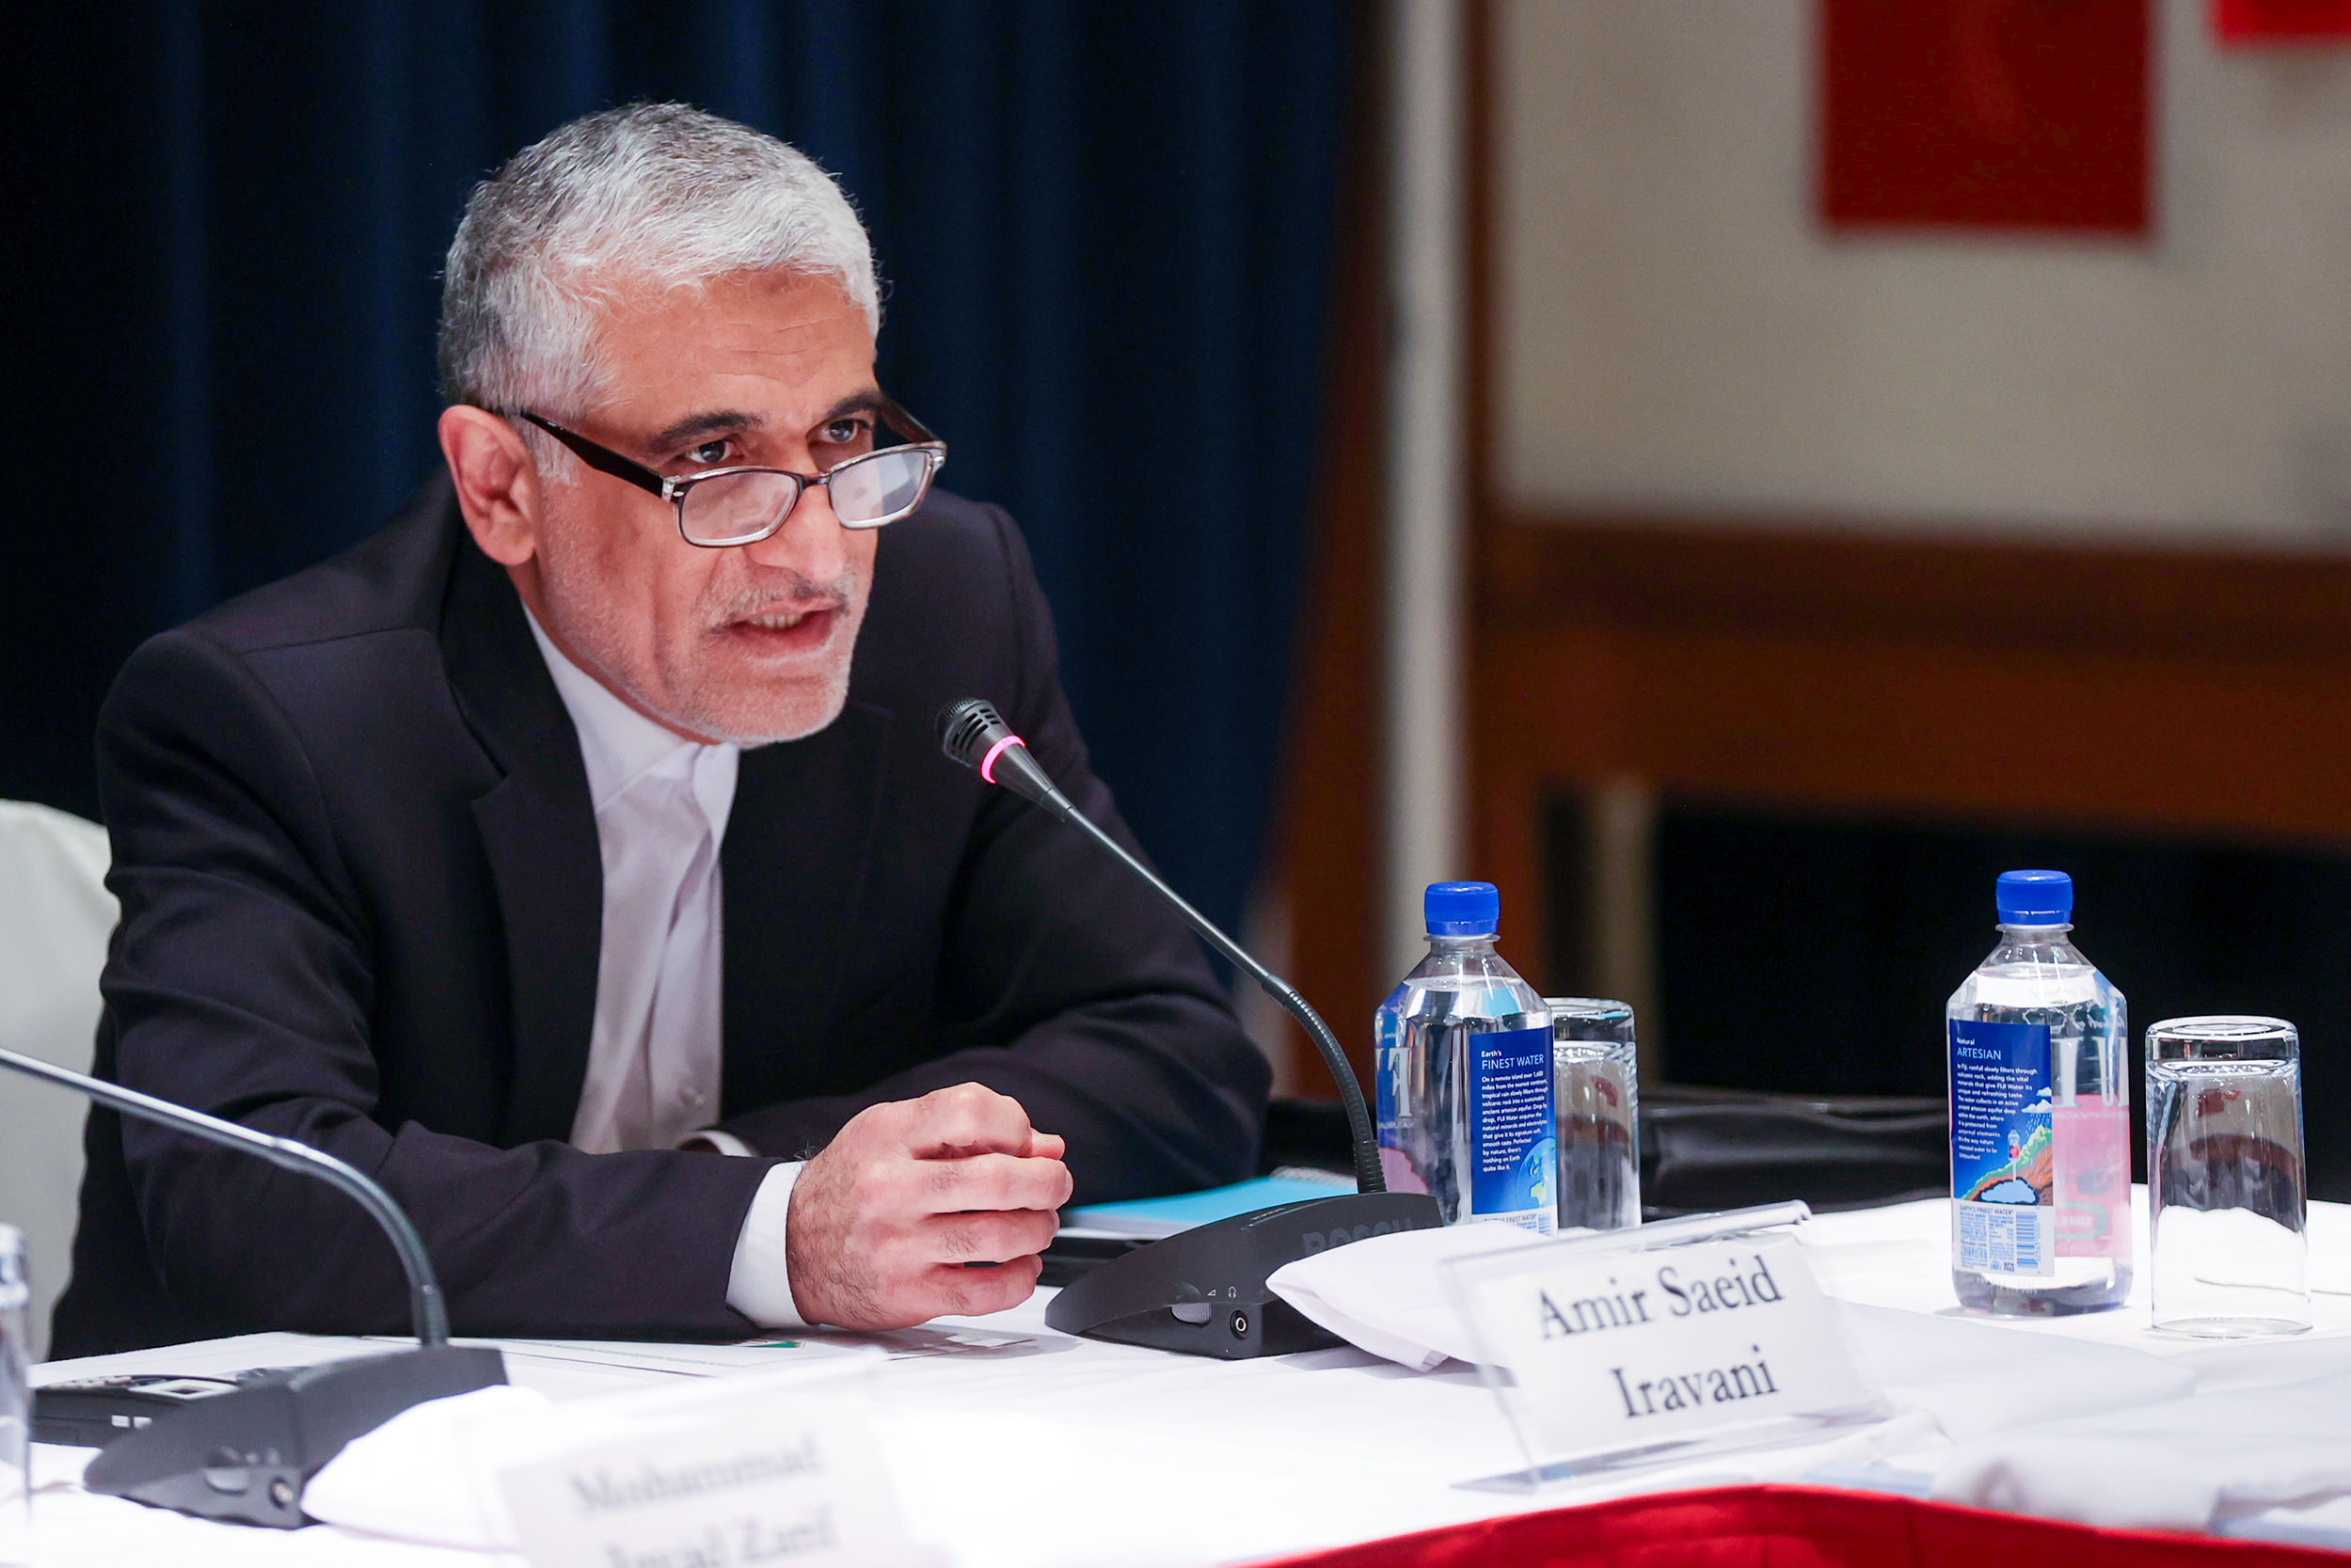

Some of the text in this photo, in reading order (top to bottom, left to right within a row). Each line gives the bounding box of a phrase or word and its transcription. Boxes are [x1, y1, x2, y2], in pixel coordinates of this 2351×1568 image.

[1482, 1054, 1544, 1070] FINEST WATER
[1957, 1047, 2001, 1060] ARTESIAN
[1537, 1254, 1786, 1341] Amir Saeid
[1610, 1344, 1782, 1419] Iravani
